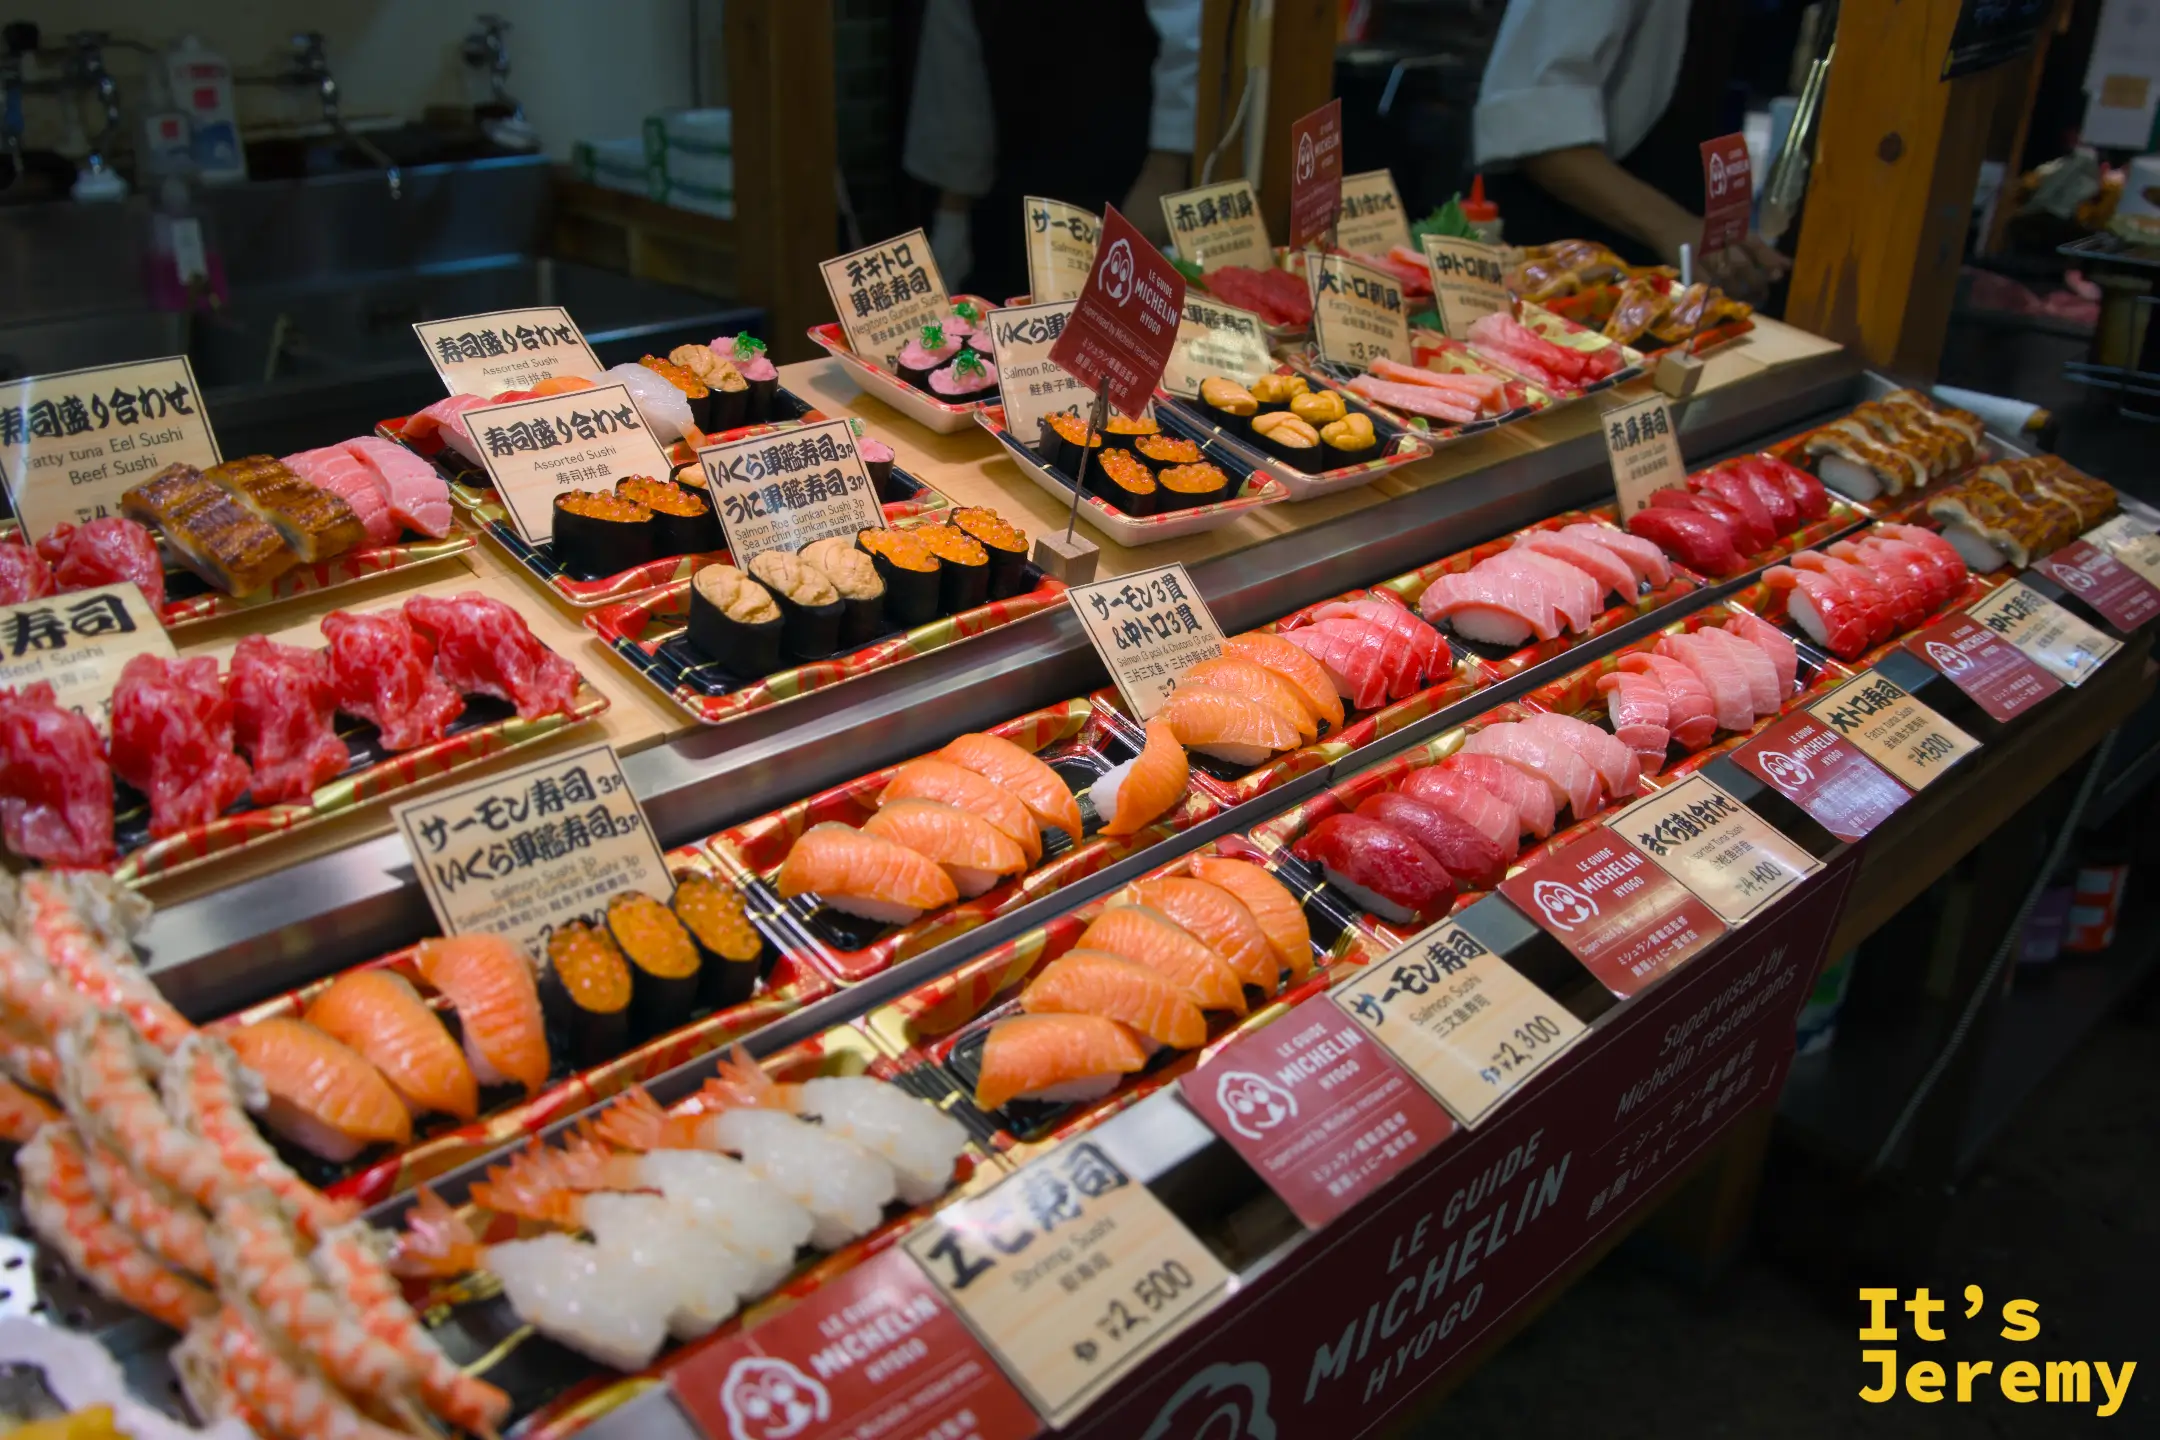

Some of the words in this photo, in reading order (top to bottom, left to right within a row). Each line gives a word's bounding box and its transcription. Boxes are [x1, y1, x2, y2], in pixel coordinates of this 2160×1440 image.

[845, 243, 914, 288] ネギトロ
[1148, 269, 1157, 282] LE
[1156, 276, 1173, 299] GUIDE
[849, 266, 932, 318] 軍艦寿司
[1134, 277, 1178, 328] MICHELIN
[1318, 268, 1401, 314] 大トロ刺身
[435, 323, 578, 365] 寿司盛り合わせ
[996, 312, 1072, 349] いくら軍
[1081, 300, 1111, 332] Supervised
[1108, 323, 1116, 337] by
[1114, 327, 1136, 349] Michelin
[1139, 310, 1161, 336] HYOGO
[482, 359, 530, 377] Assorted
[530, 355, 559, 370] Sushi
[1003, 362, 1039, 380] Salmon
[1042, 361, 1062, 374] Roe
[0, 381, 194, 447] 寿司盛り合わせ
[483, 402, 641, 458] 寿司盛り合わせ
[69, 446, 104, 462] tuna
[109, 434, 135, 454] Eel
[139, 426, 183, 447] Sushi
[534, 453, 585, 472] Assorted
[588, 445, 617, 461] Sushi
[69, 464, 109, 486] Beef
[113, 453, 159, 476] Sushi
[735, 523, 769, 541] Salmon
[770, 518, 789, 532] Roe
[791, 508, 826, 525] Gunkan
[828, 502, 852, 515] Sushi
[853, 498, 865, 511] 3p
[742, 539, 760, 551] Sea
[762, 529, 793, 545] urchin
[793, 520, 828, 539] gunkan
[829, 513, 852, 526] sushi
[853, 509, 866, 524] 3p
[1089, 572, 1188, 621] サーモン3貫
[51, 645, 104, 666] Sushi
[1117, 654, 1141, 668] Salmon
[1141, 650, 1149, 662] (3
[1149, 645, 1163, 660] pcs)
[1163, 647, 1169, 656] &
[1169, 639, 1194, 654] Chutoro
[1193, 636, 1201, 647] (3
[1201, 632, 1216, 644] pcs)
[1955, 629, 1996, 653] MICHELIN
[1826, 678, 1907, 734] 大トロ寿司
[1864, 724, 1888, 741] Fatty
[1884, 715, 1901, 729] tuna
[1896, 706, 1916, 719] Sushi
[1787, 735, 1799, 745] LE
[1796, 724, 1816, 742] GUIDE
[1792, 729, 1840, 762] MICHELIN
[1820, 749, 1844, 767] HYOGO
[1637, 793, 1740, 857] まぐろ盛り合わせ
[1710, 832, 1730, 850] Tuna
[1725, 823, 1746, 841] Sushi
[1575, 860, 1591, 873] LE
[1587, 846, 1615, 869] GUIDE
[1578, 851, 1645, 895] MICHELIN
[1613, 875, 1645, 899] HYOGO
[1348, 927, 1488, 1028] サーモン寿司
[1408, 991, 1456, 1027] Salmon
[1448, 972, 1484, 1001] Sushi
[1659, 955, 1766, 1057] Supervised
[1764, 943, 1789, 976] by
[1276, 1043, 1292, 1059] LE
[1292, 1022, 1328, 1051] GUIDE
[1276, 1026, 1364, 1088] MICHELIN
[1614, 1046, 1695, 1122] Michelin
[1698, 963, 1798, 1056] restaurants
[1317, 1059, 1361, 1092] HYOGO
[1386, 1212, 1433, 1275] LE
[1442, 1128, 1545, 1230] GUIDE
[1069, 1217, 1117, 1250] Sushi
[1303, 1151, 1572, 1405] MICHELIN
[809, 1294, 940, 1379] MICHELIN
[1363, 1282, 1484, 1404] HYOGO
